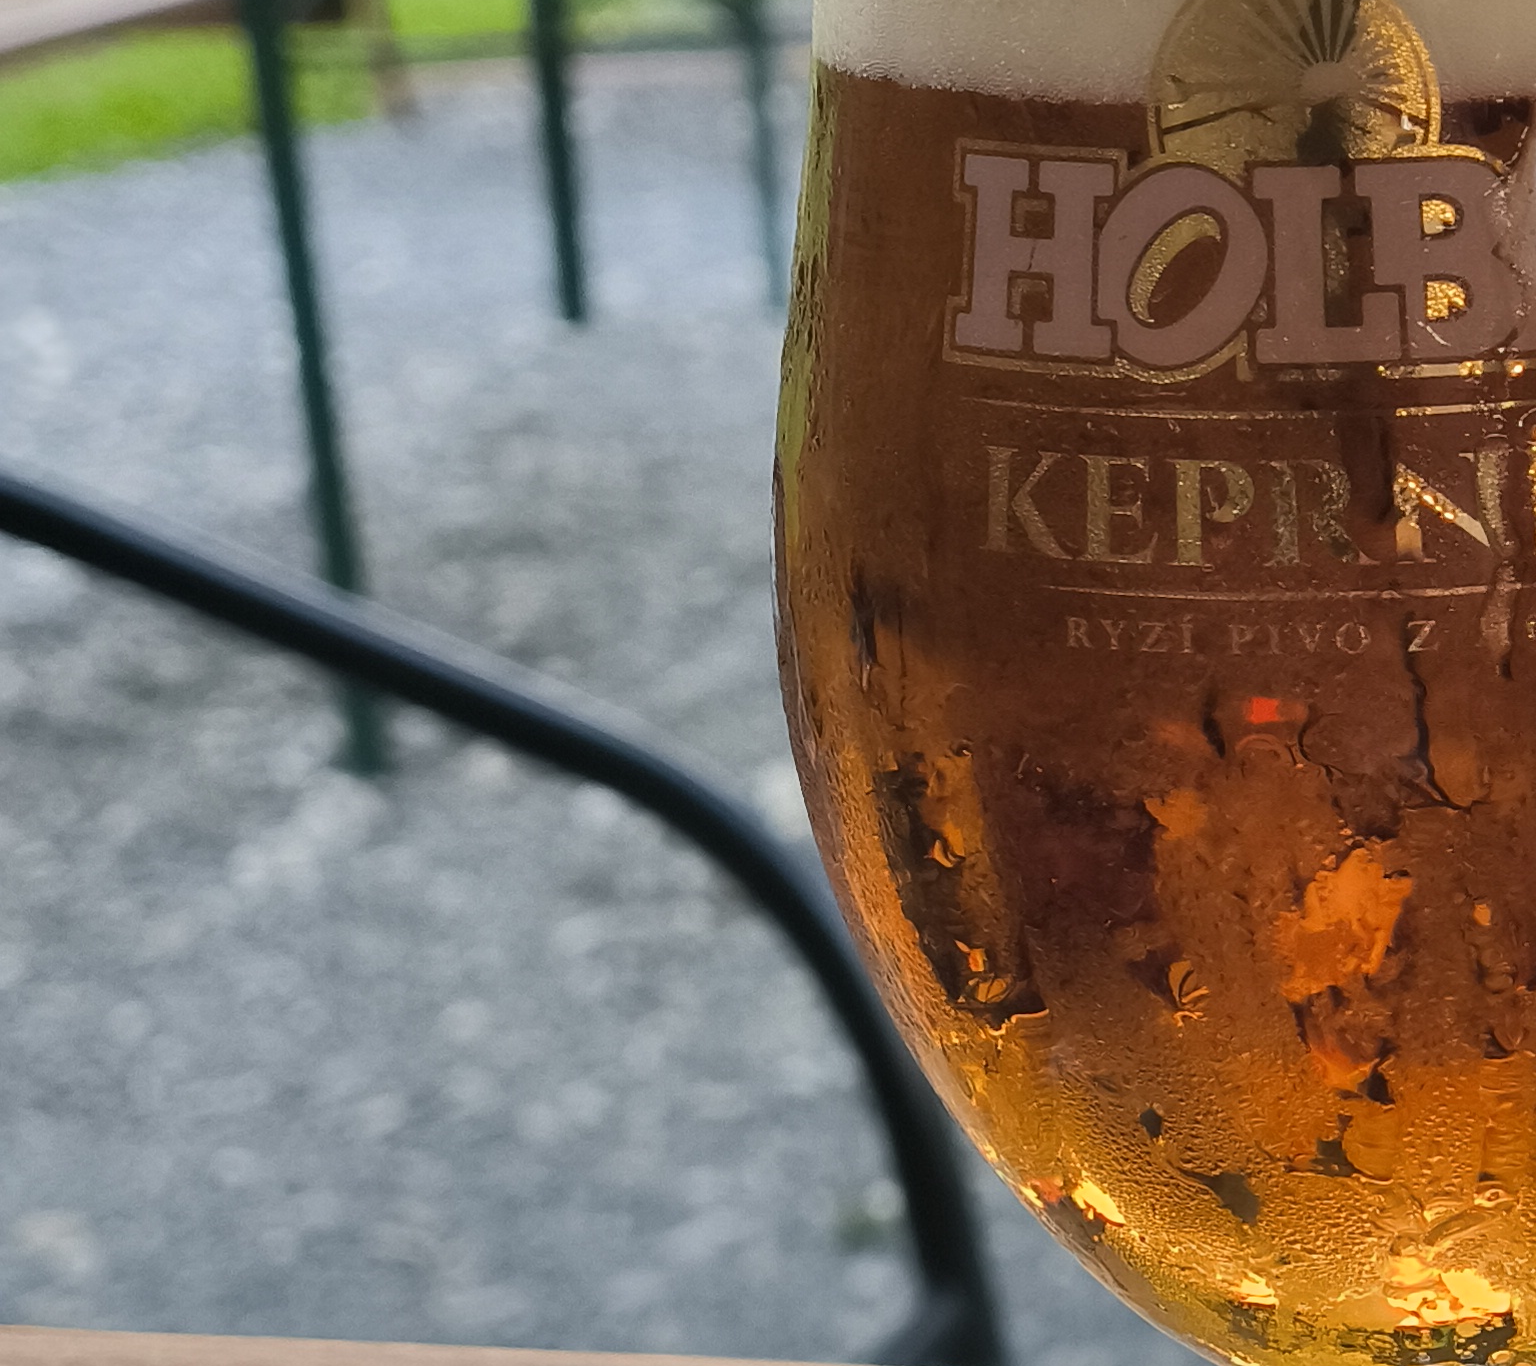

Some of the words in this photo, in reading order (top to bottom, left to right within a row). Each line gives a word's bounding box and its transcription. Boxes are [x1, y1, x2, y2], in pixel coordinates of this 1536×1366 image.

[1066, 614, 1195, 655] RYZÍ
[1229, 619, 1372, 656] PIVO
[1407, 619, 1439, 653] Z
